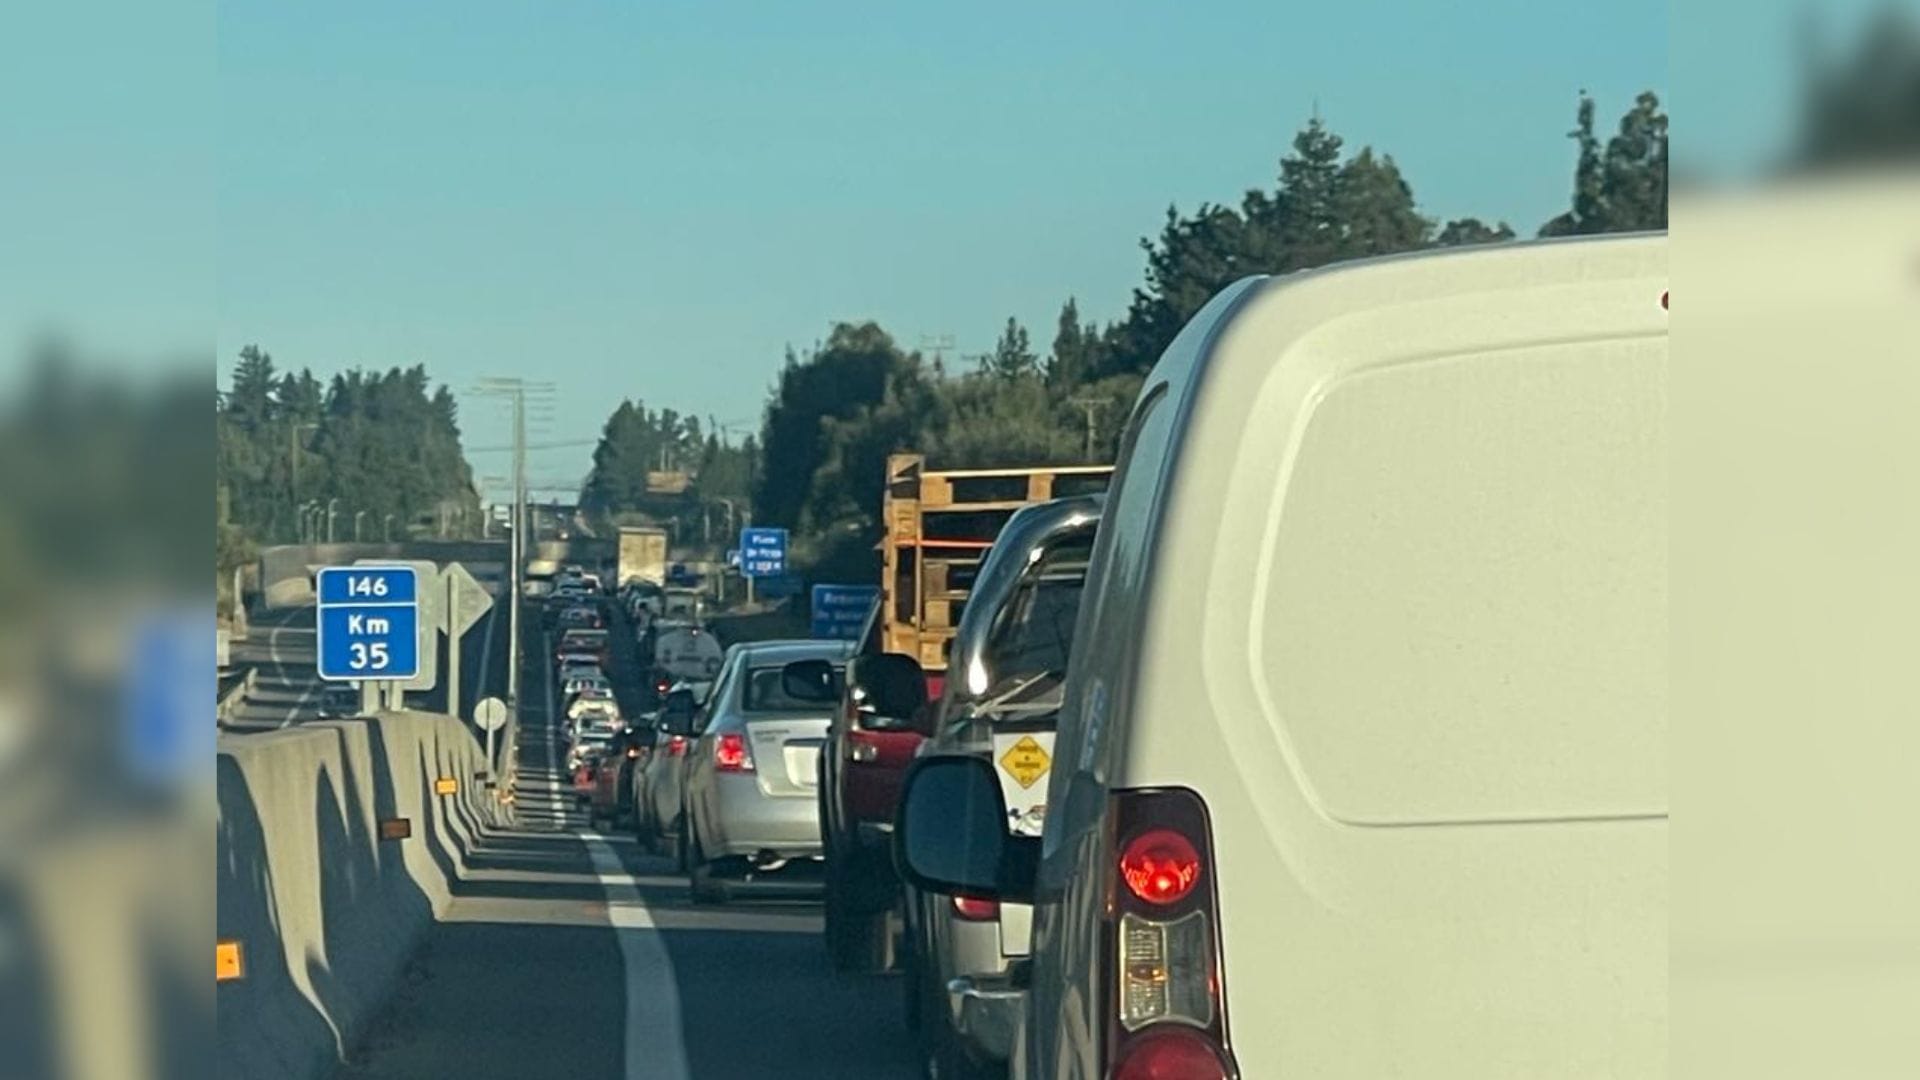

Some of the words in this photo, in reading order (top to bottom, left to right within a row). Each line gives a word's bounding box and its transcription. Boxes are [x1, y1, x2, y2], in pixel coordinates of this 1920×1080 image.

[348, 576, 389, 597] 146
[348, 614, 389, 635] Km
[349, 642, 389, 669] 35
